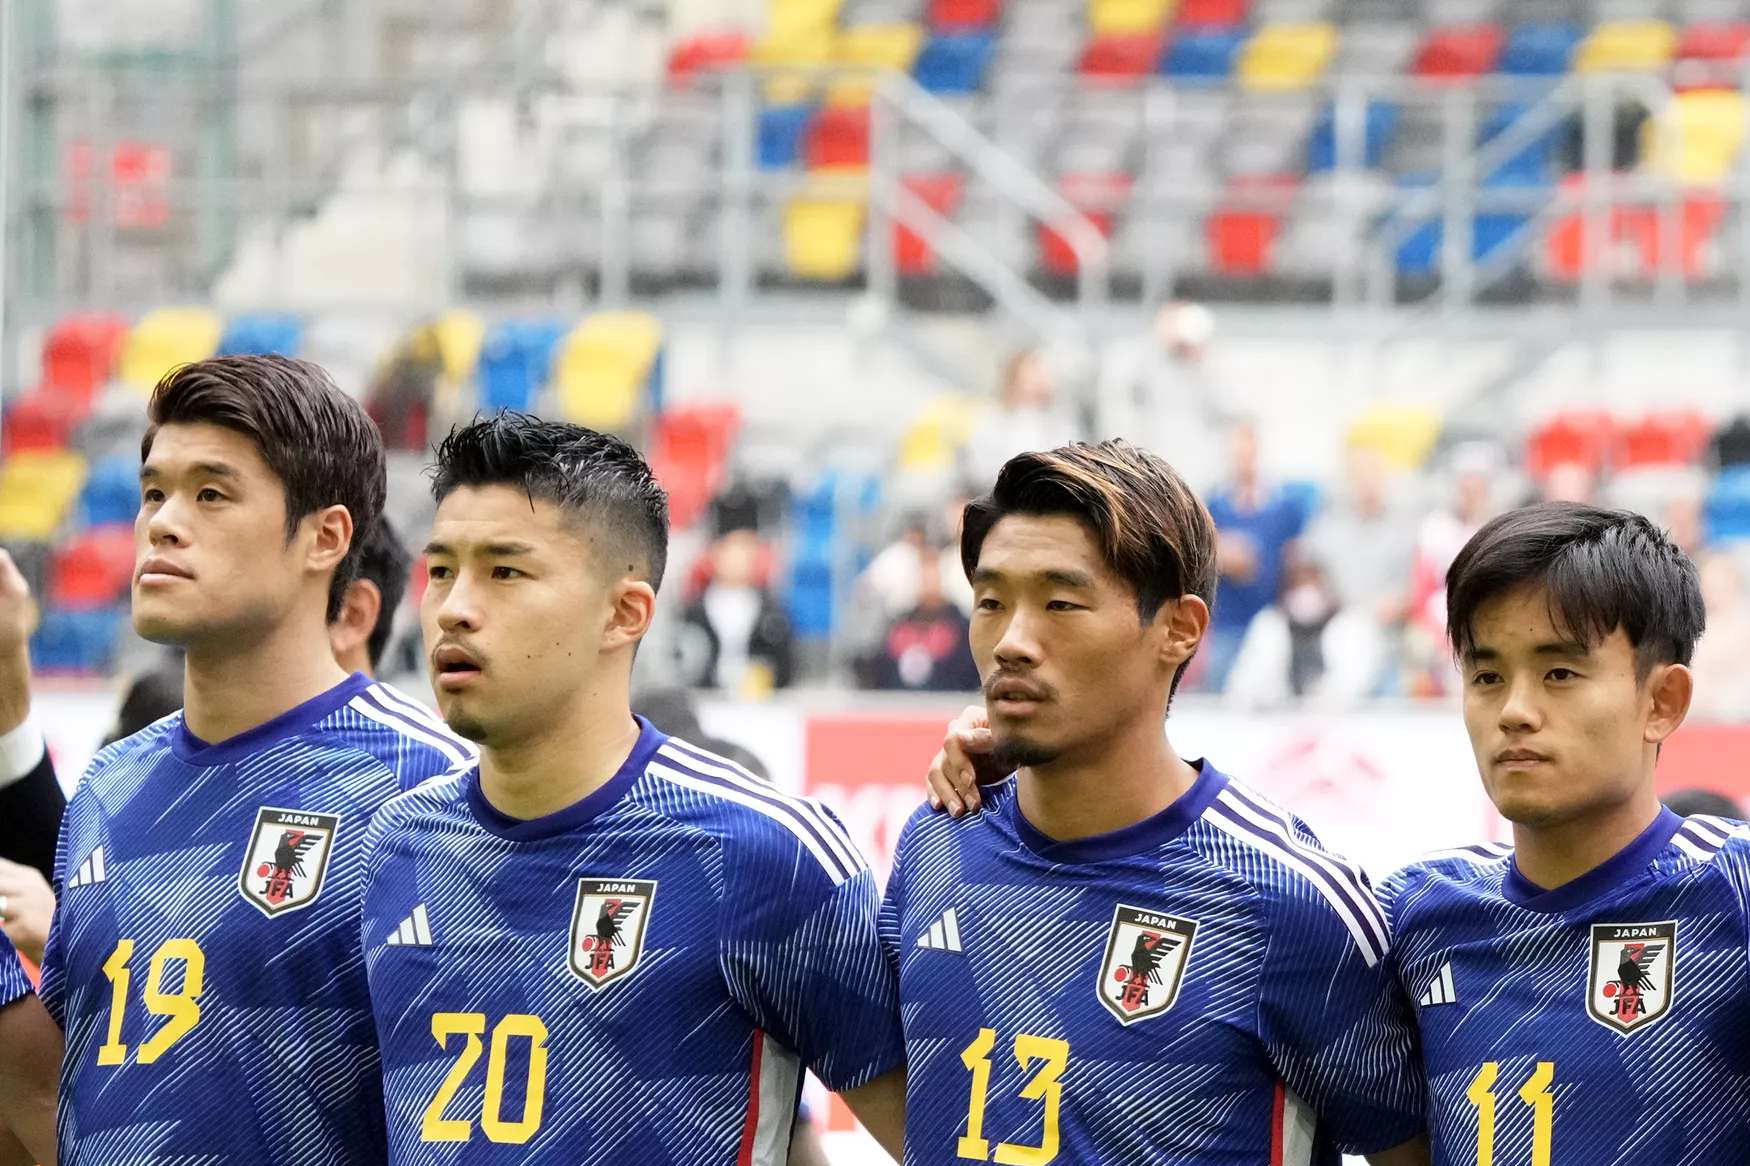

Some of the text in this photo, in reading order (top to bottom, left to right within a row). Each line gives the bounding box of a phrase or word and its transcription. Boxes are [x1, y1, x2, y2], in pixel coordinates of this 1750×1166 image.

[277, 813, 320, 826] JAPAN
[259, 880, 294, 899] JFA
[597, 883, 636, 893] JAPAN
[1134, 912, 1177, 930] JAPAN
[1613, 927, 1657, 938] JAPAN
[584, 953, 615, 970] JFA
[98, 938, 205, 1066] 19
[1115, 983, 1149, 1007] JFA
[1609, 998, 1647, 1015] JFA
[422, 1012, 547, 1143] 20
[957, 1029, 1069, 1166] 13
